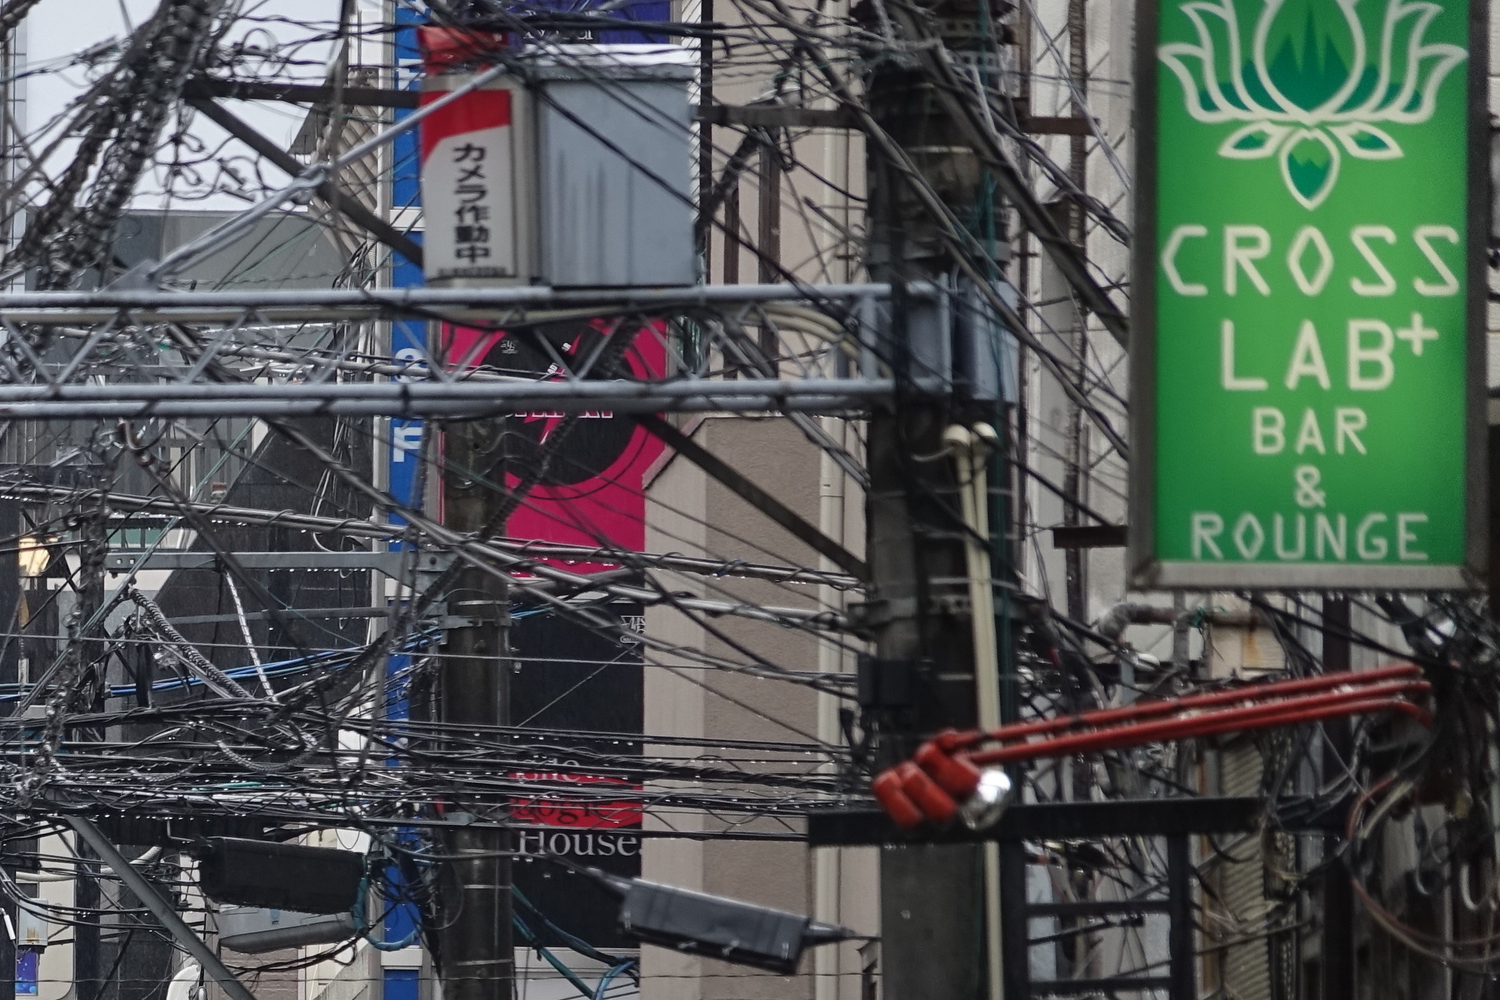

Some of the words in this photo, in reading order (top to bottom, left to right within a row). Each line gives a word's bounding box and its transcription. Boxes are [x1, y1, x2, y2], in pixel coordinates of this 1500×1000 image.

[453, 143, 491, 264] カメラ作動中
[1162, 225, 1460, 295] CROSS
[1254, 407, 1367, 454] BAR
[1294, 464, 1325, 507] &
[1192, 512, 1428, 560] ROUNGE
